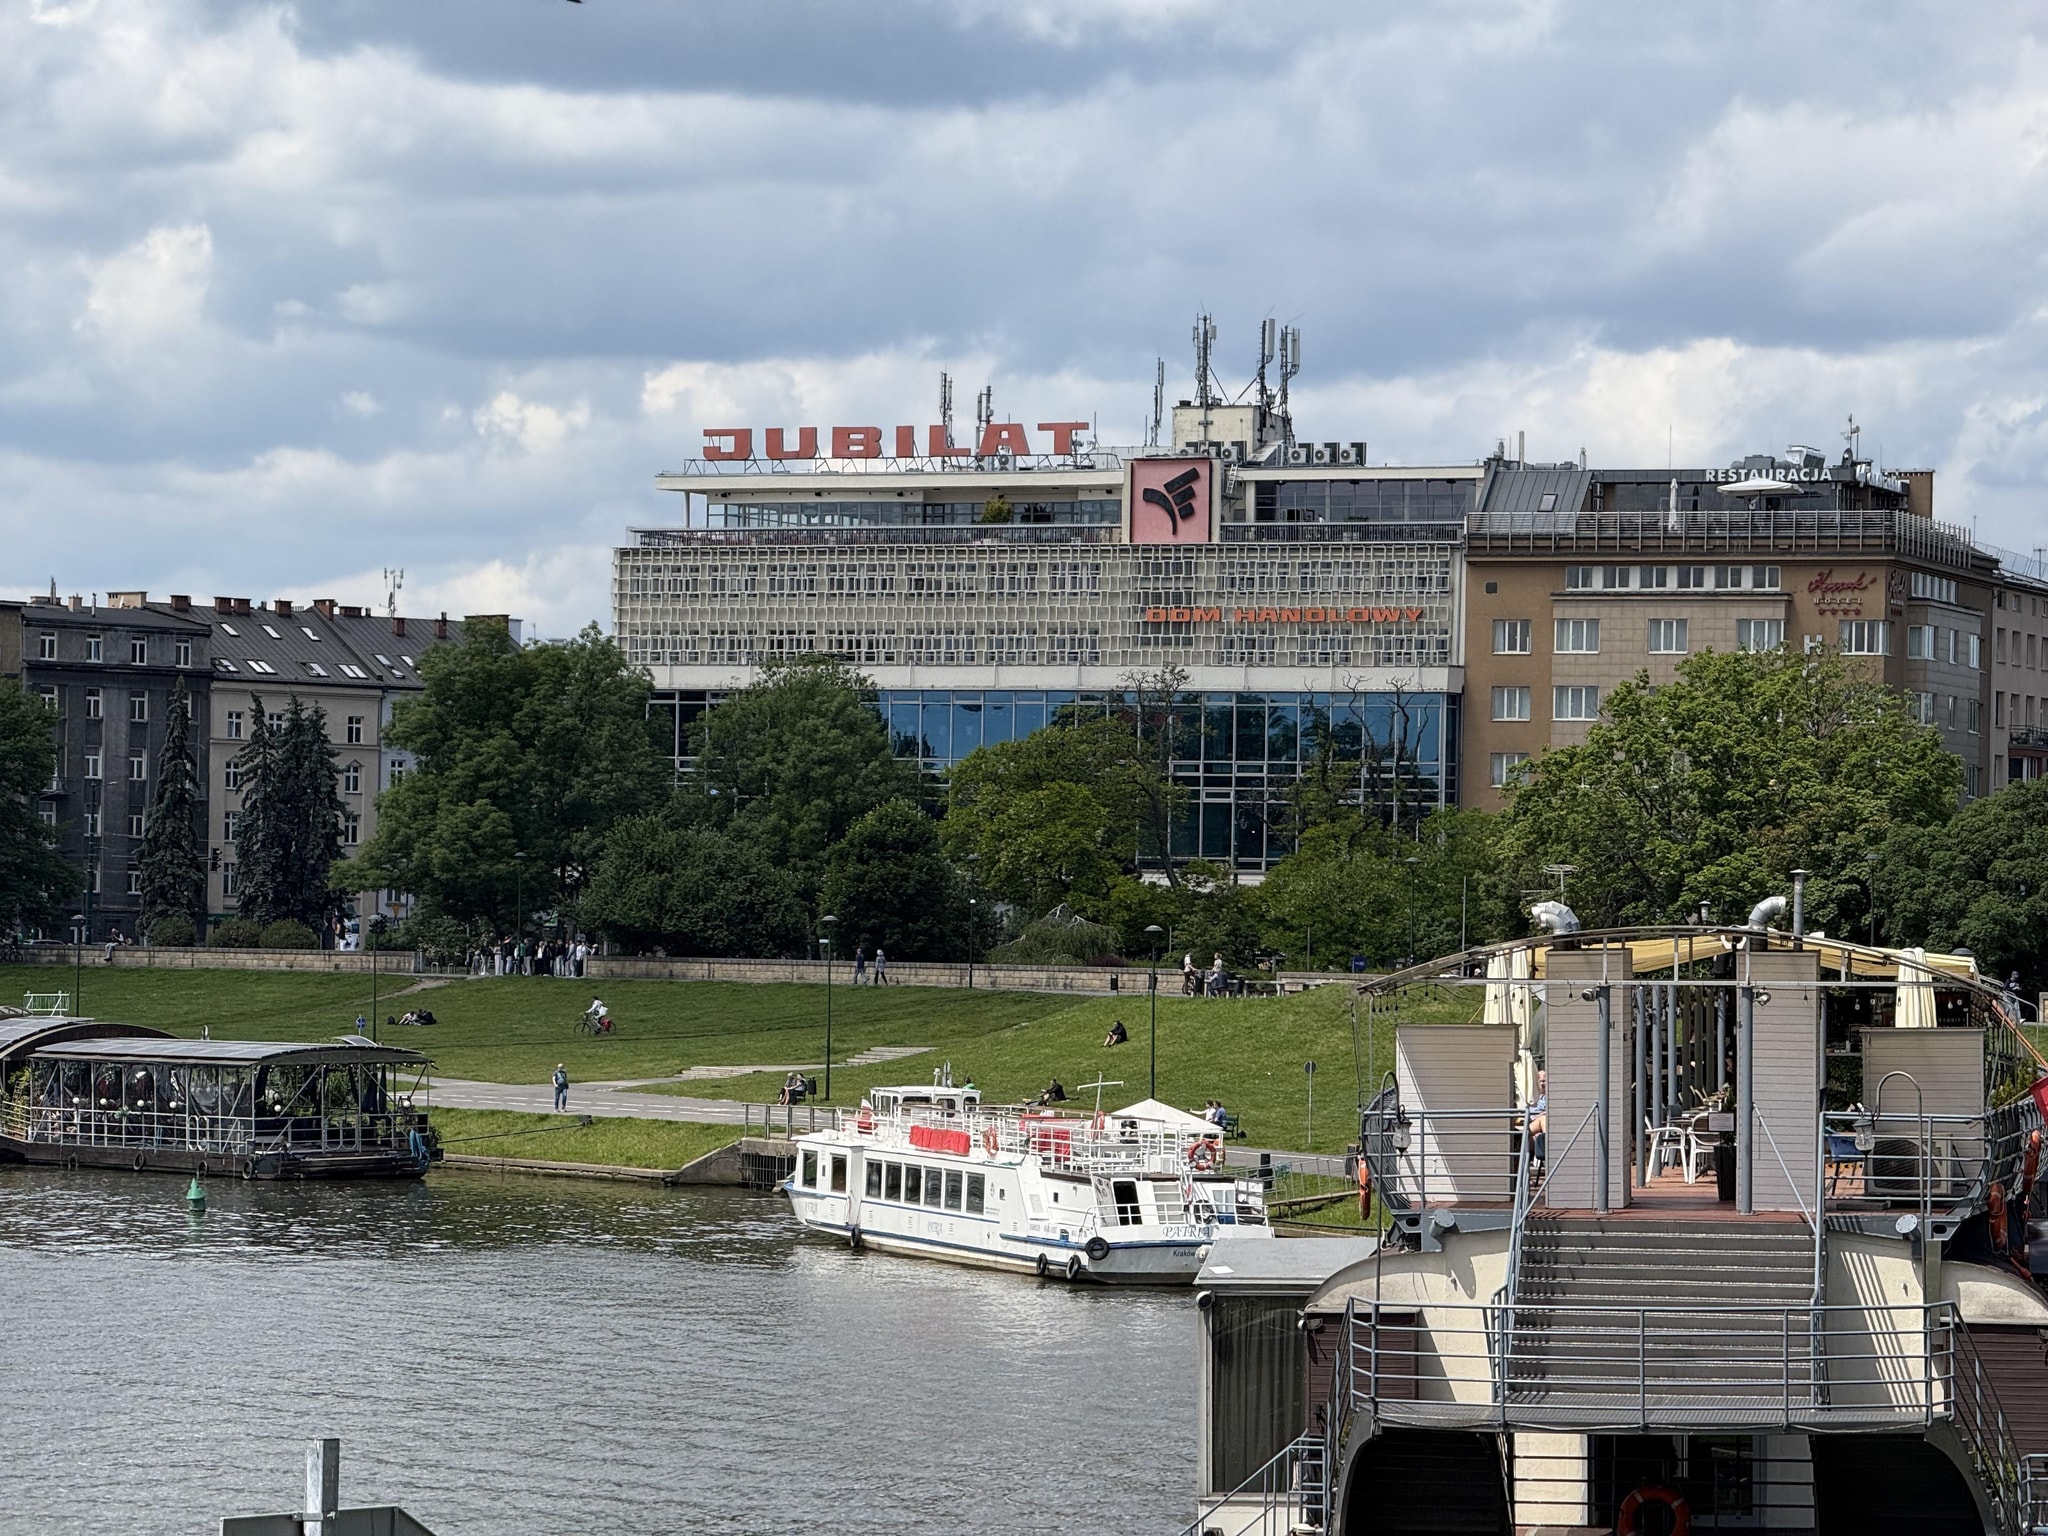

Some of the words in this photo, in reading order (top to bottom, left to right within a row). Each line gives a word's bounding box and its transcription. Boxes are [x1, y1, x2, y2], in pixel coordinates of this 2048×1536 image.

[703, 422, 1090, 461] JUBILAT
[1705, 468, 1833, 482] RESTAURACJA
[1813, 597, 1863, 605] HOTEL
[1146, 608, 1222, 623] DOM
[1234, 608, 1424, 623] HANDLOWY
[1162, 1225, 1211, 1239] PATRIA
